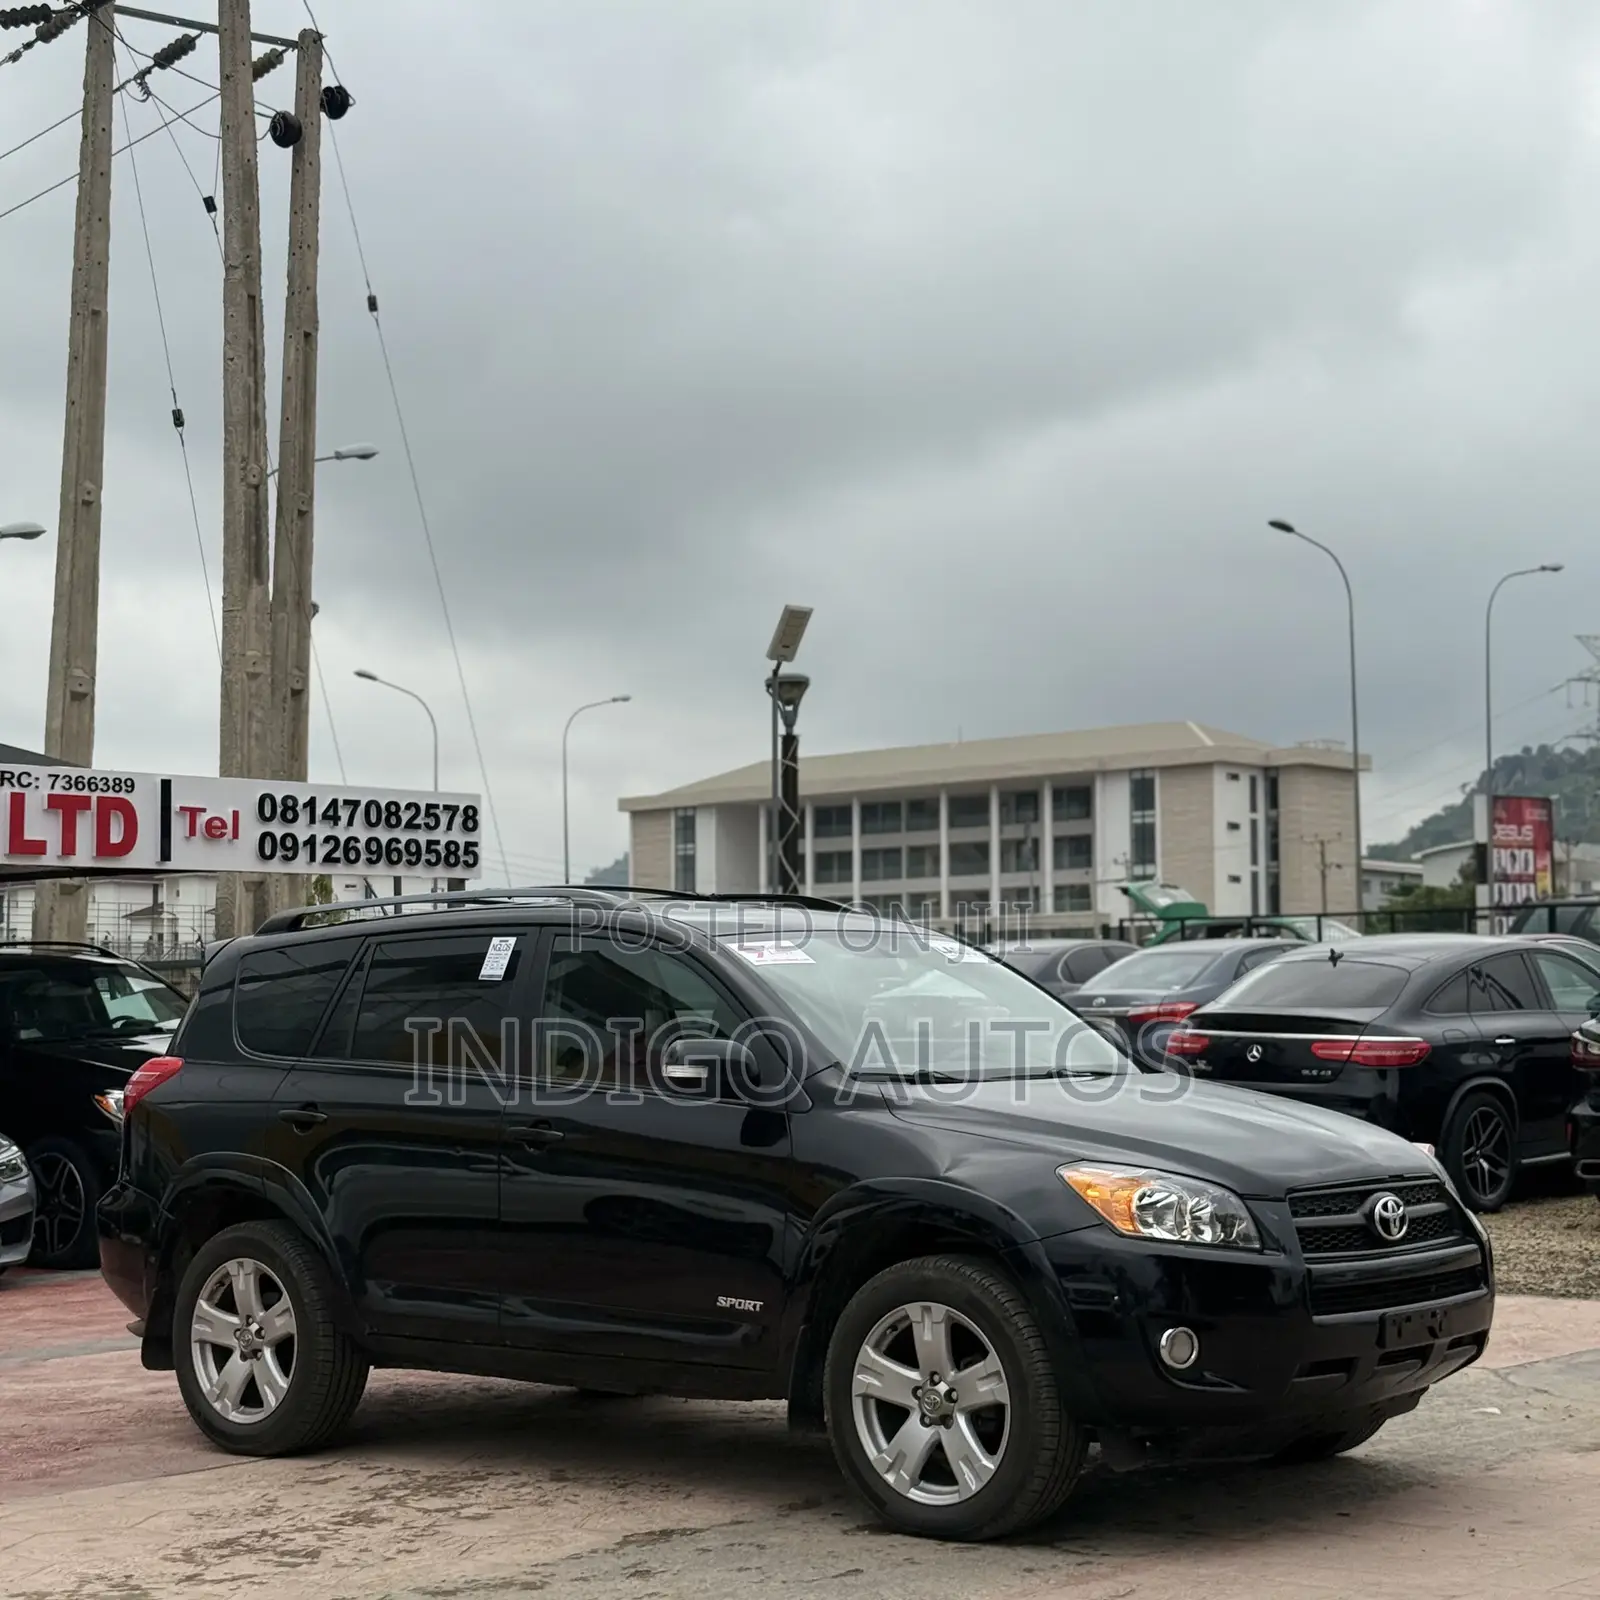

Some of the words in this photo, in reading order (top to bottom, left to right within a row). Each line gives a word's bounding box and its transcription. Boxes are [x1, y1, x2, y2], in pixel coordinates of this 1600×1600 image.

[0, 771, 40, 789] RC:
[48, 774, 135, 793] 7366389
[8, 791, 138, 857] LTD
[177, 805, 239, 840] Tel
[257, 792, 479, 832] 08147082578
[257, 830, 479, 869] 09126969585
[716, 1296, 764, 1312] SPORT
